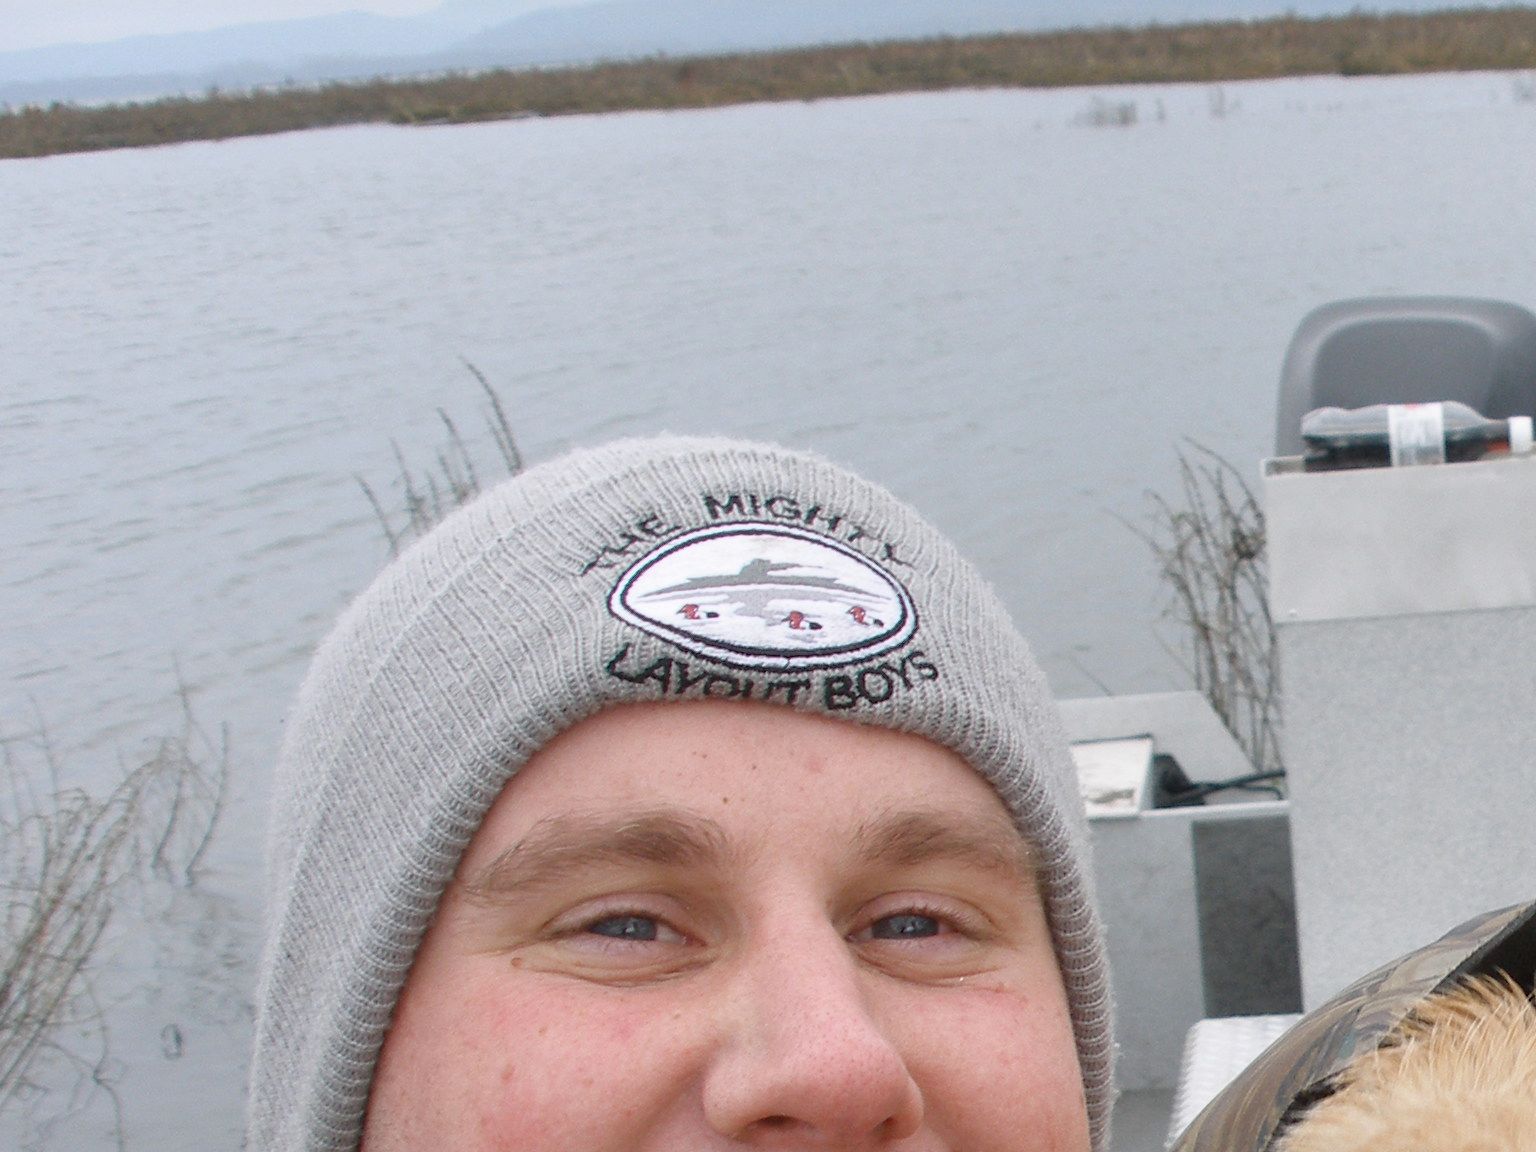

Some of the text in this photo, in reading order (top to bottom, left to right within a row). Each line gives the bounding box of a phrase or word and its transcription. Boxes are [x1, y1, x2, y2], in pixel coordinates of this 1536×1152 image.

[580, 493, 915, 576] THE MIGHTY
[606, 643, 940, 711] LAYOUT BOYS
